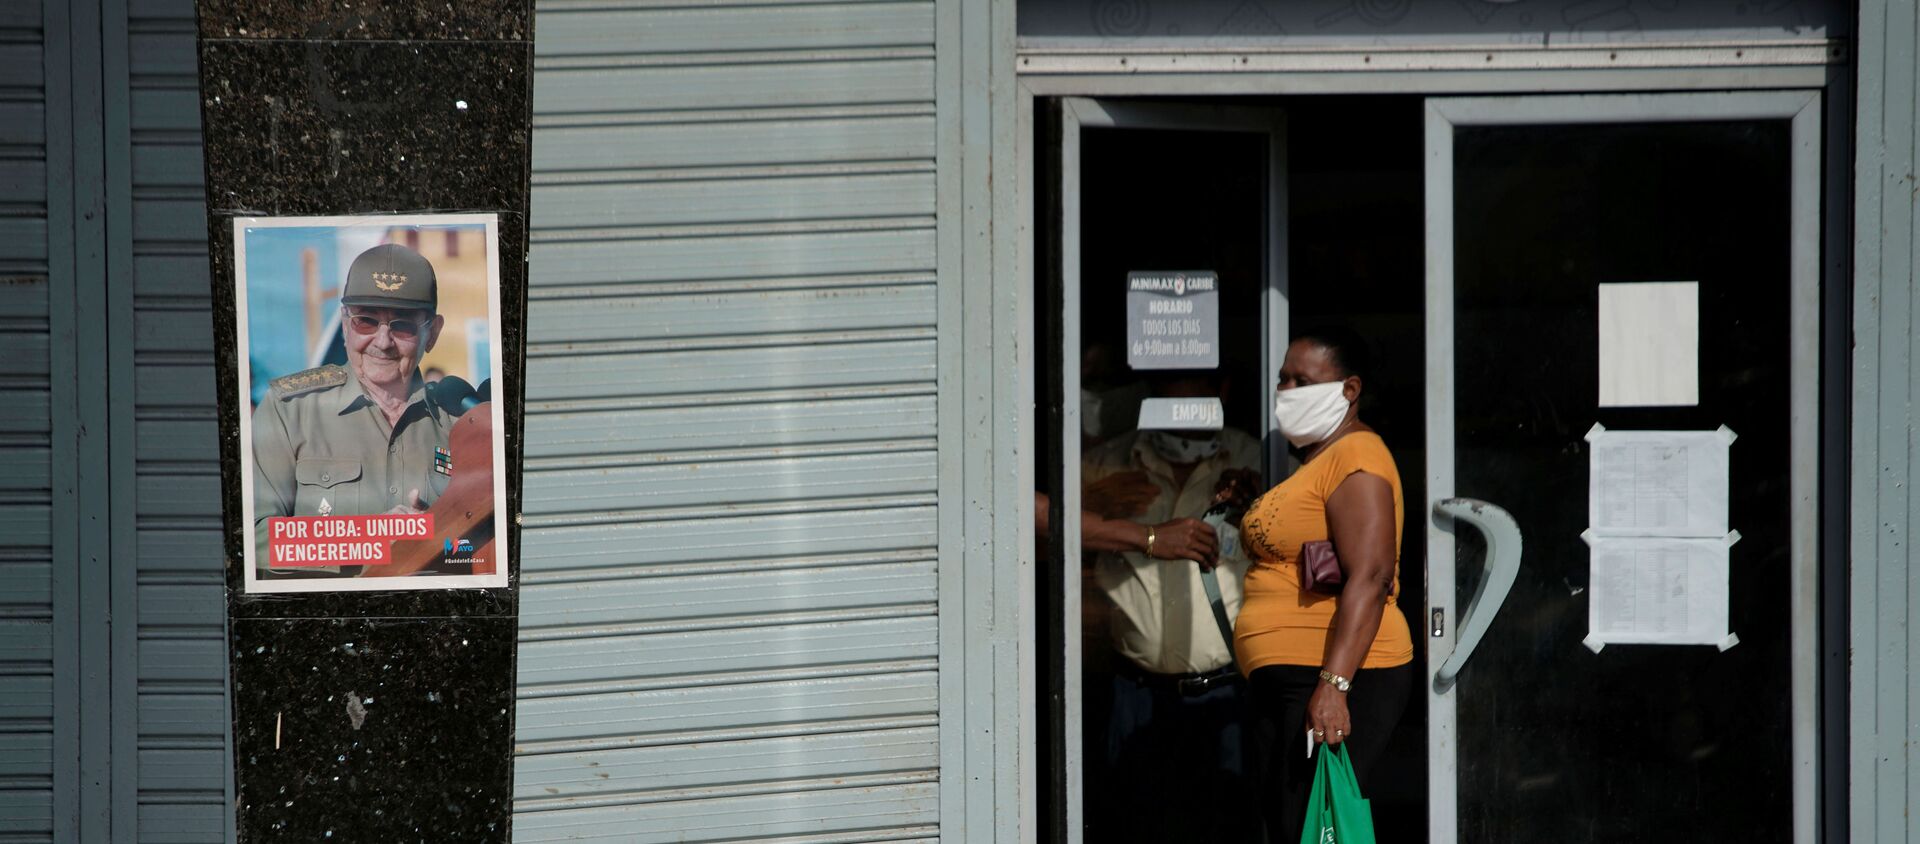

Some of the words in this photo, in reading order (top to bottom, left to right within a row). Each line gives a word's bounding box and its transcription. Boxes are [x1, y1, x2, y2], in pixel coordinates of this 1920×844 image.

[1130, 278, 1174, 290] MINIMAX
[1186, 278, 1214, 290] CARIBE
[1150, 300, 1193, 314] HORARIO
[1142, 319, 1167, 335] TODOS
[1167, 319, 1182, 335] LOS
[1133, 340, 1143, 355] de
[1144, 340, 1174, 356] 9:00am
[1175, 343, 1180, 354] a
[1182, 340, 1211, 356] 8:00pm
[1172, 404, 1219, 424] EMPUJE
[275, 521, 308, 538] POR
[313, 519, 361, 537] CUBA:
[366, 518, 427, 537] UNIDOS
[275, 542, 383, 562] VENCEREMOS
